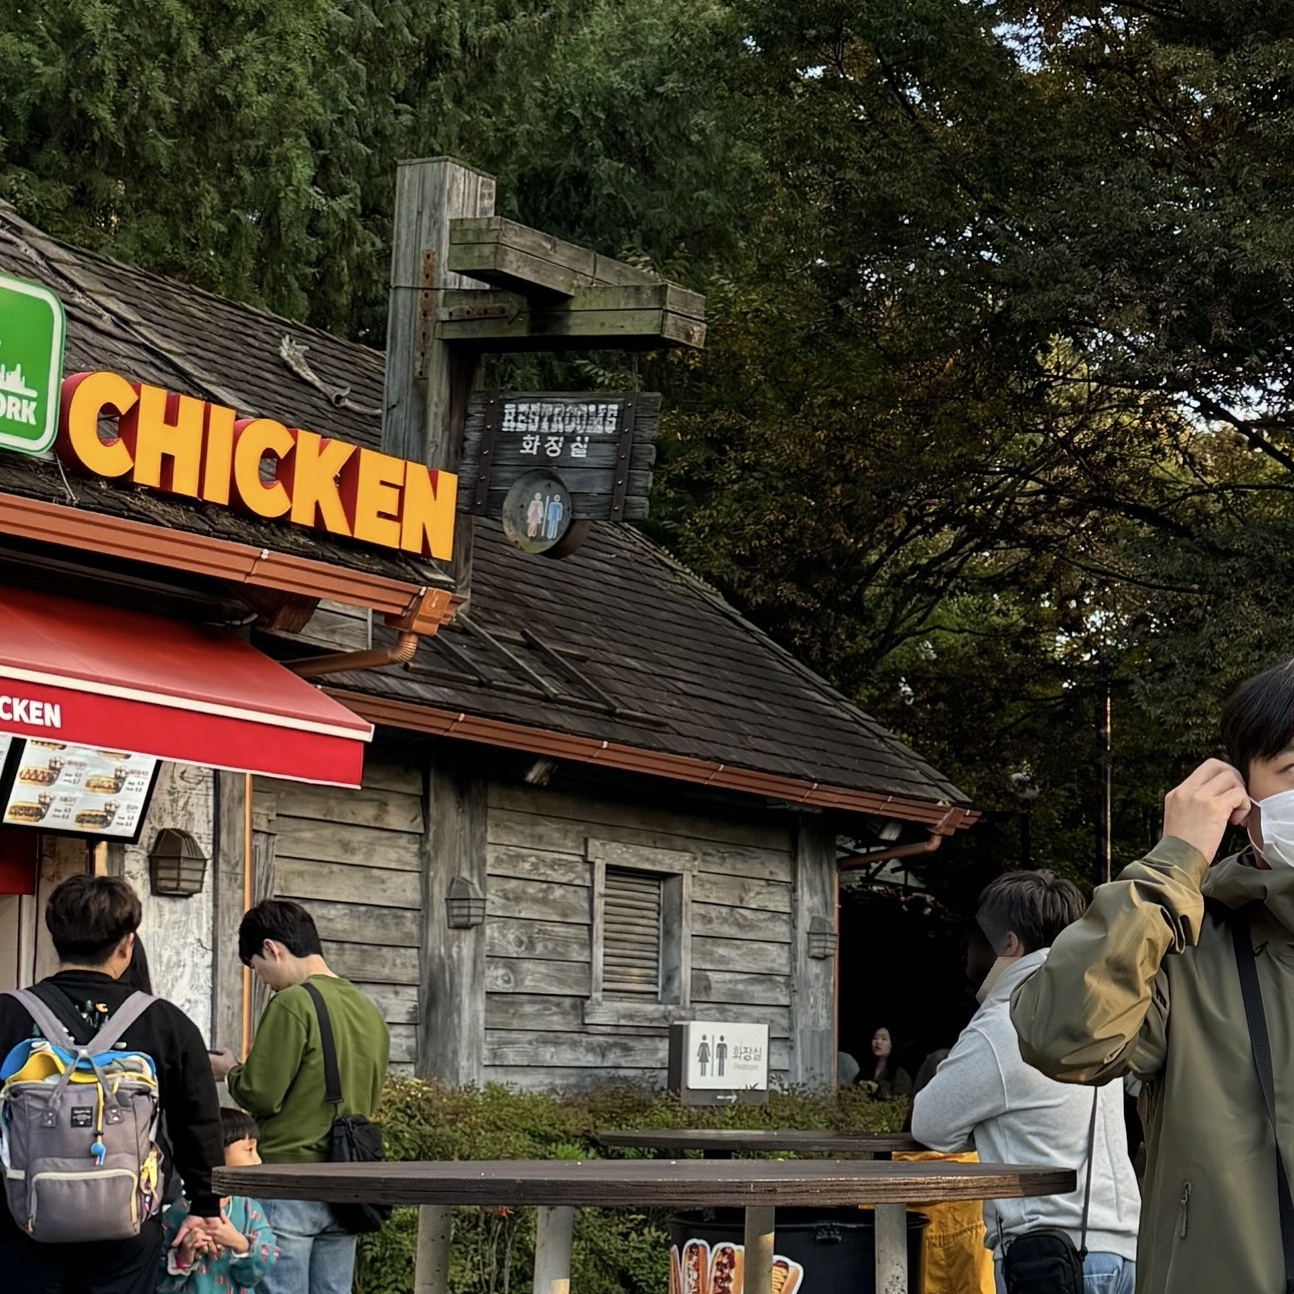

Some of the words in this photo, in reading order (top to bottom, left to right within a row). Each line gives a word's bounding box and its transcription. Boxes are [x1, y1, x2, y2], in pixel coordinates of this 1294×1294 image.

[502, 403, 619, 433] RESTROOMS
[520, 434, 589, 458] 화장실
[67, 371, 459, 562] CHICKEN
[0, 695, 61, 728] CKEN
[732, 1045, 762, 1062] 화장실
